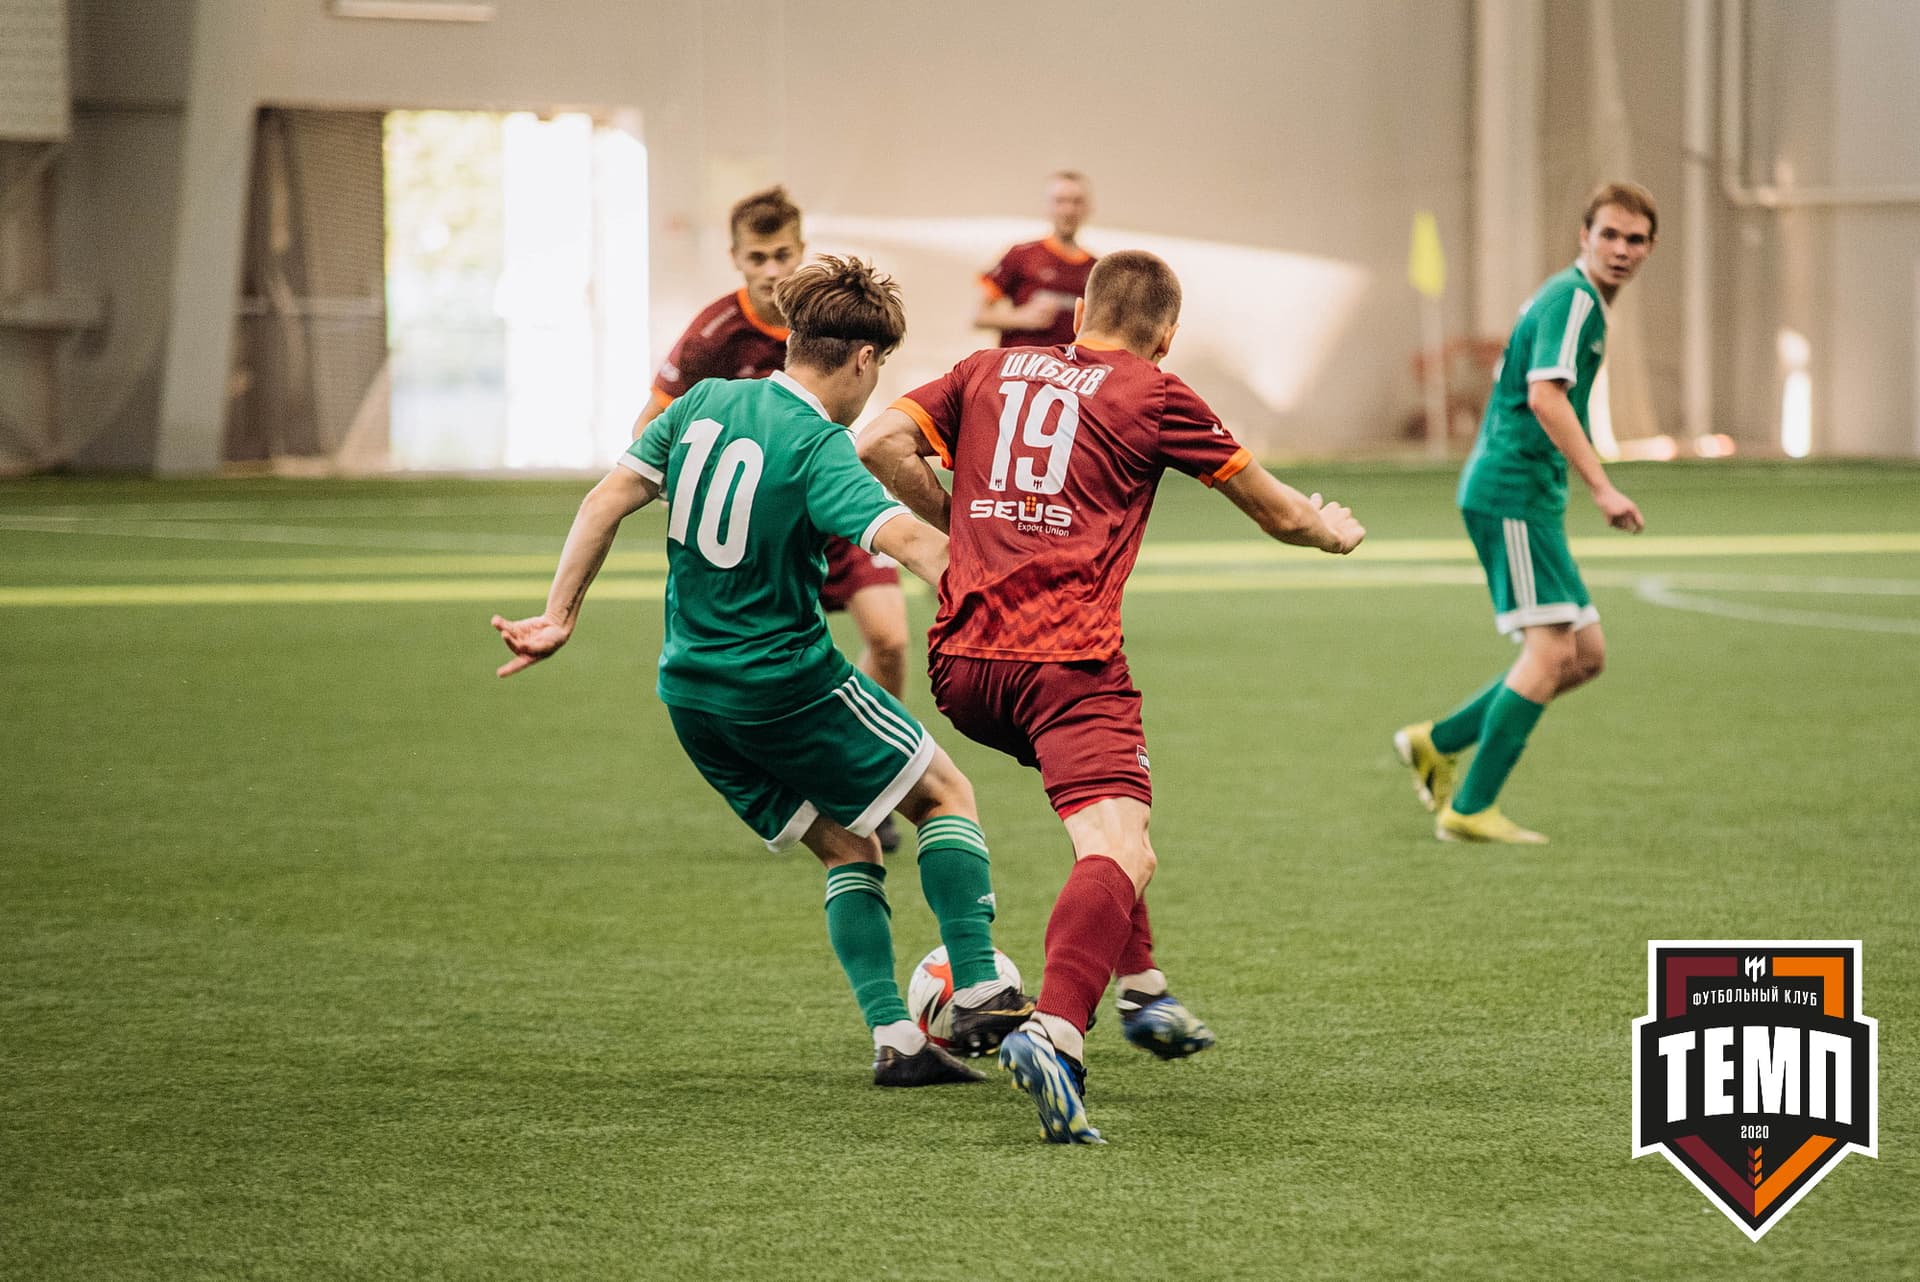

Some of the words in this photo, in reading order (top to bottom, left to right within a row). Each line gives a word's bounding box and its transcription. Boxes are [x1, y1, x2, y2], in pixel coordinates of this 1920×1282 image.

[668, 418, 764, 568] 10
[989, 381, 1079, 495] 19
[1017, 522, 1043, 533] Export
[1045, 525, 1070, 537] Union
